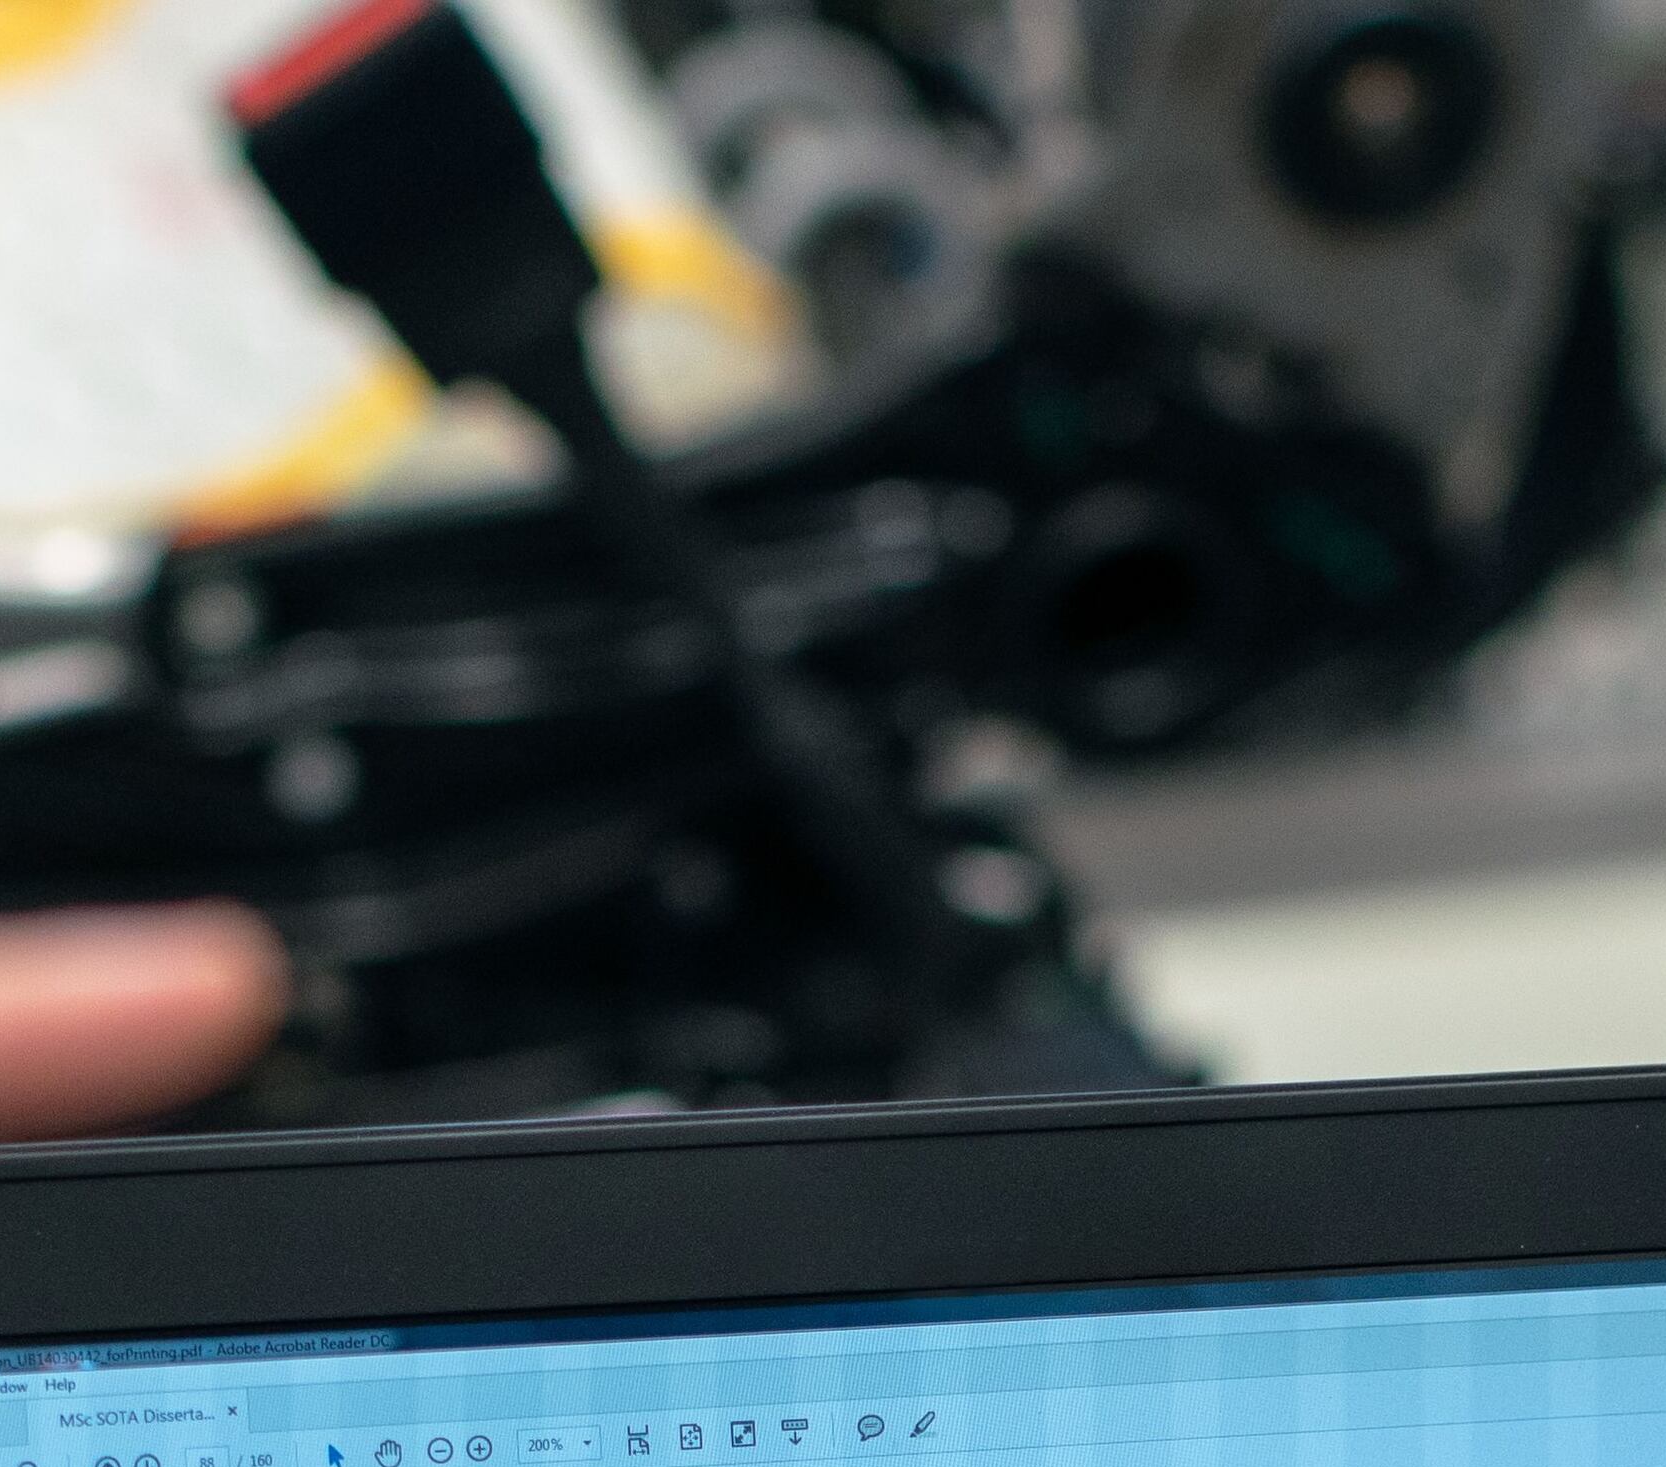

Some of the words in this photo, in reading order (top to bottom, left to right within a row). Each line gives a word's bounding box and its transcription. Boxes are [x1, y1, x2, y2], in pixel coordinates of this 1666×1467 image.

[217, 1343, 260, 1356] Adobe
[265, 1339, 316, 1354] Acrobat
[321, 1337, 365, 1350] Reader
[371, 1334, 390, 1348] DC
[45, 1378, 76, 1394] Help
[60, 1413, 92, 1429] MSc
[97, 1410, 139, 1427] SOTA
[528, 1437, 564, 1453] 200%
